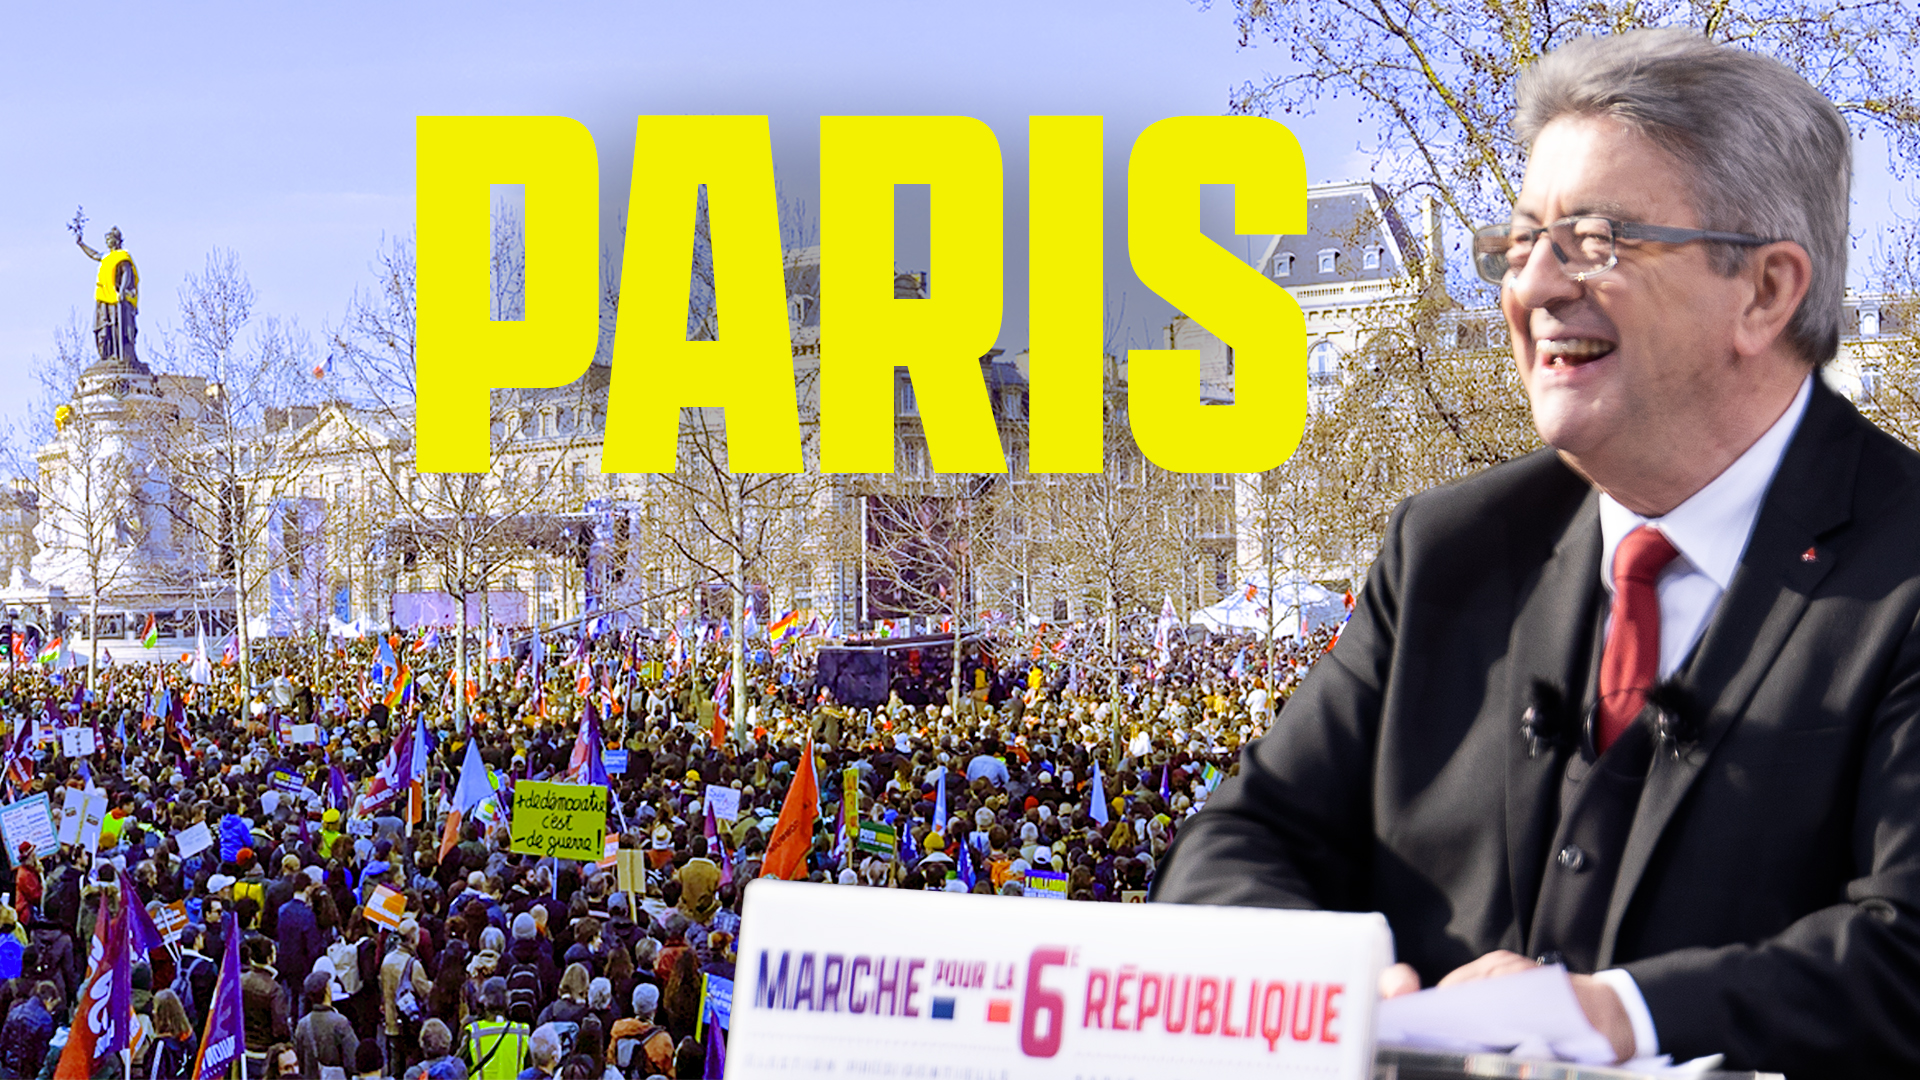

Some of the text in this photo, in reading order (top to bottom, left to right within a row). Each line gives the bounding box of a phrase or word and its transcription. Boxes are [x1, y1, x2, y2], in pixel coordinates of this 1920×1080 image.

[755, 949, 925, 1017] MARCHE
[932, 961, 986, 988] POUR
[994, 961, 1015, 990] LA
[1082, 963, 1345, 1052] RÉPUBLIQUE
